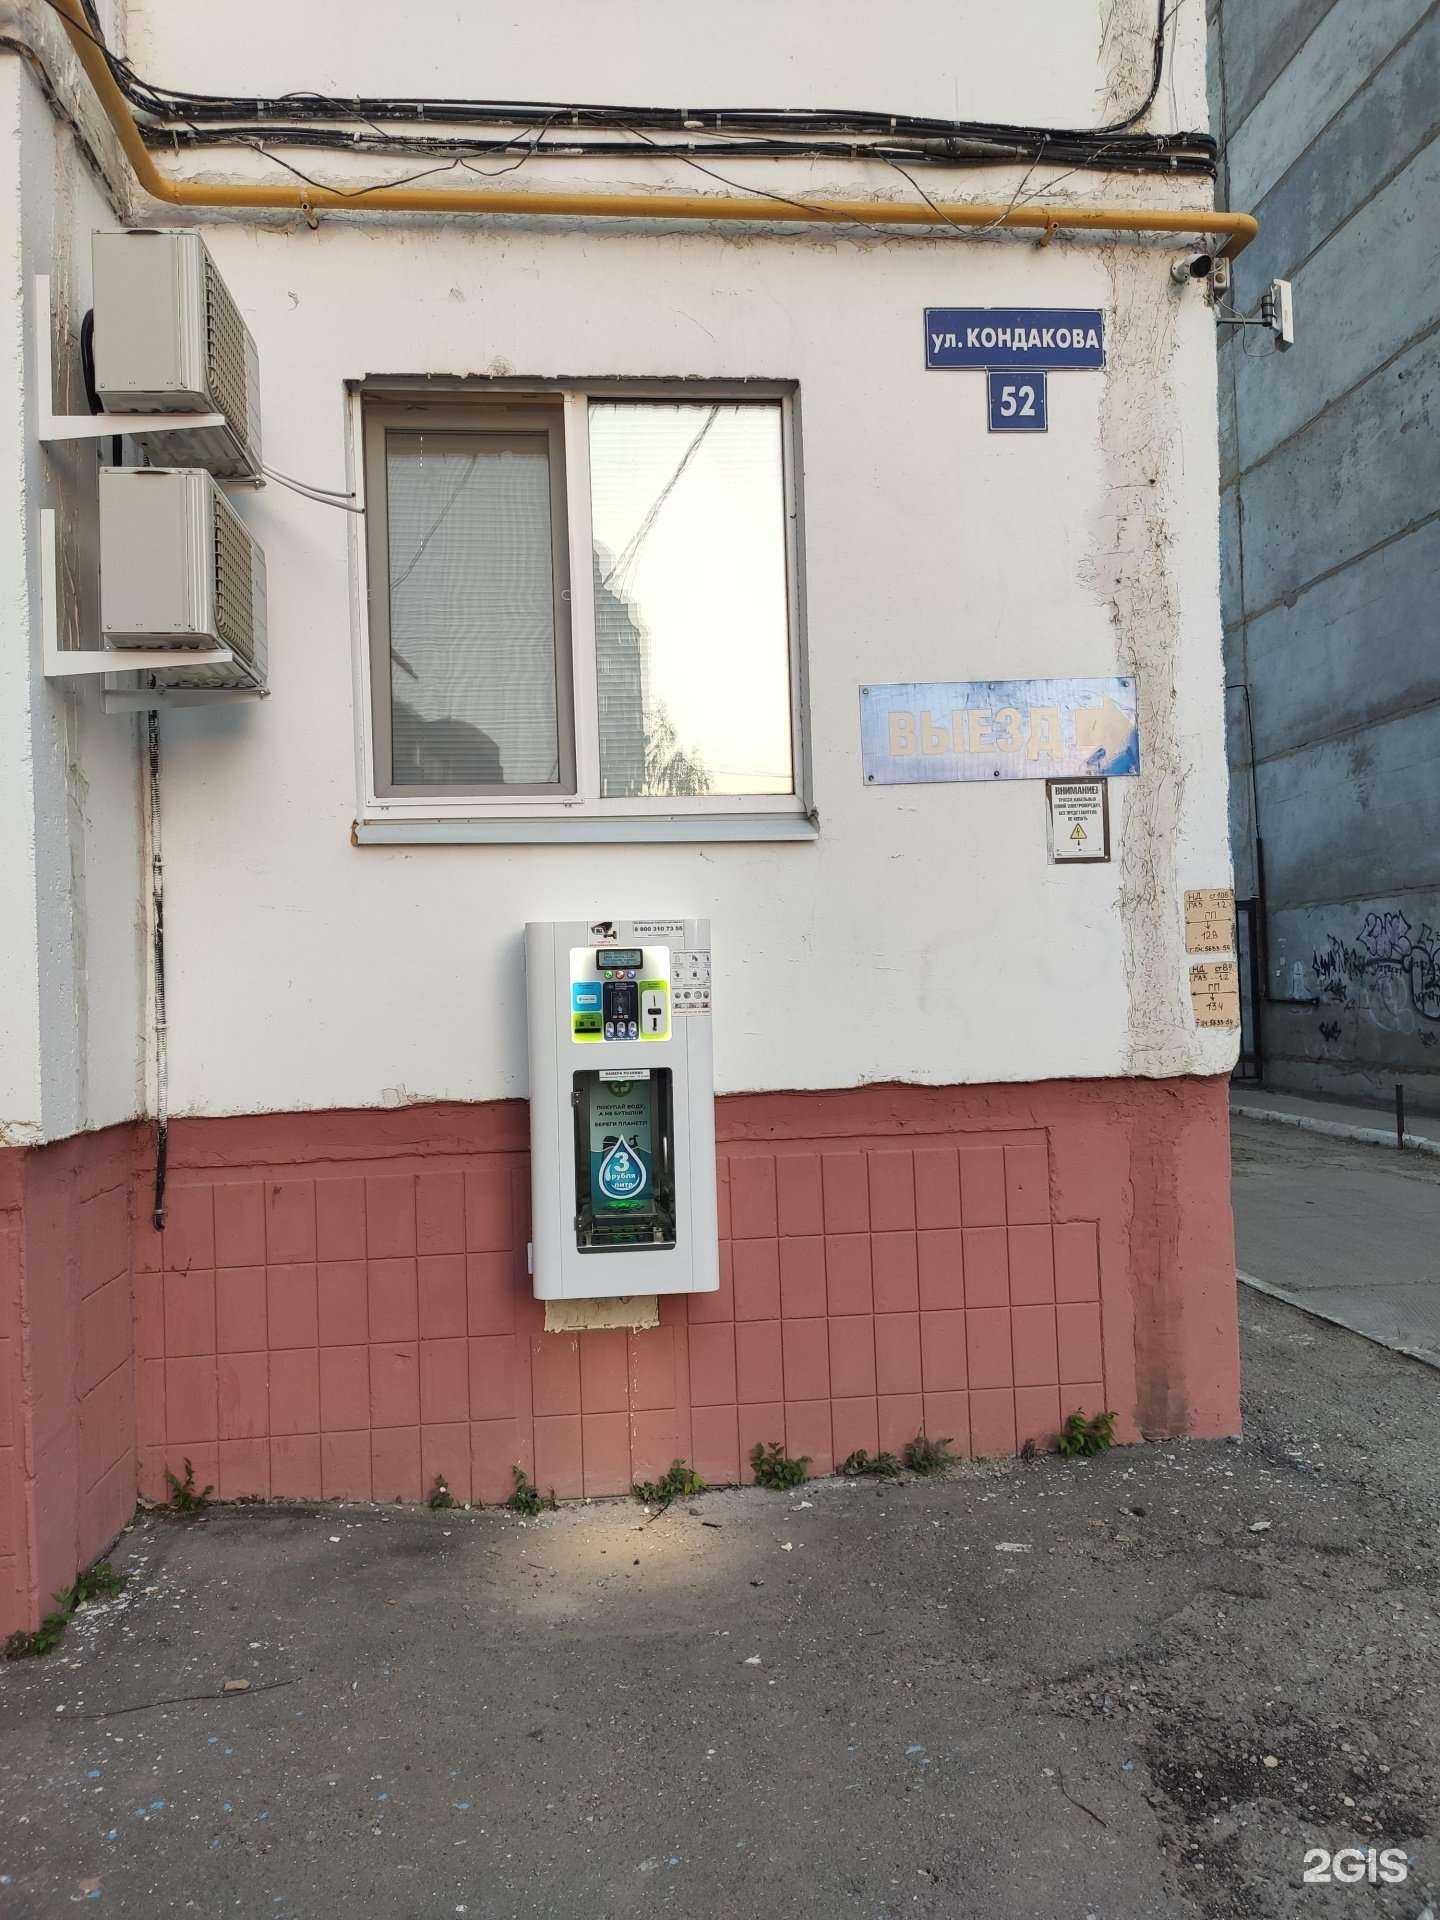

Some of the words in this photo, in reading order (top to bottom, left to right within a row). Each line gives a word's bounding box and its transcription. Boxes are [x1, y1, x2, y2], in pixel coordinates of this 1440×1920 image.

[931, 333, 963, 354] ул.
[967, 328, 1100, 351] КОНДАКОВА
[1000, 385, 1036, 417] 52
[888, 706, 1064, 762] ВЫЕЗД
[1055, 785, 1099, 796] ВНИМАНИЕ!
[614, 1151, 630, 1172] 3
[611, 1173, 636, 1181] рубля
